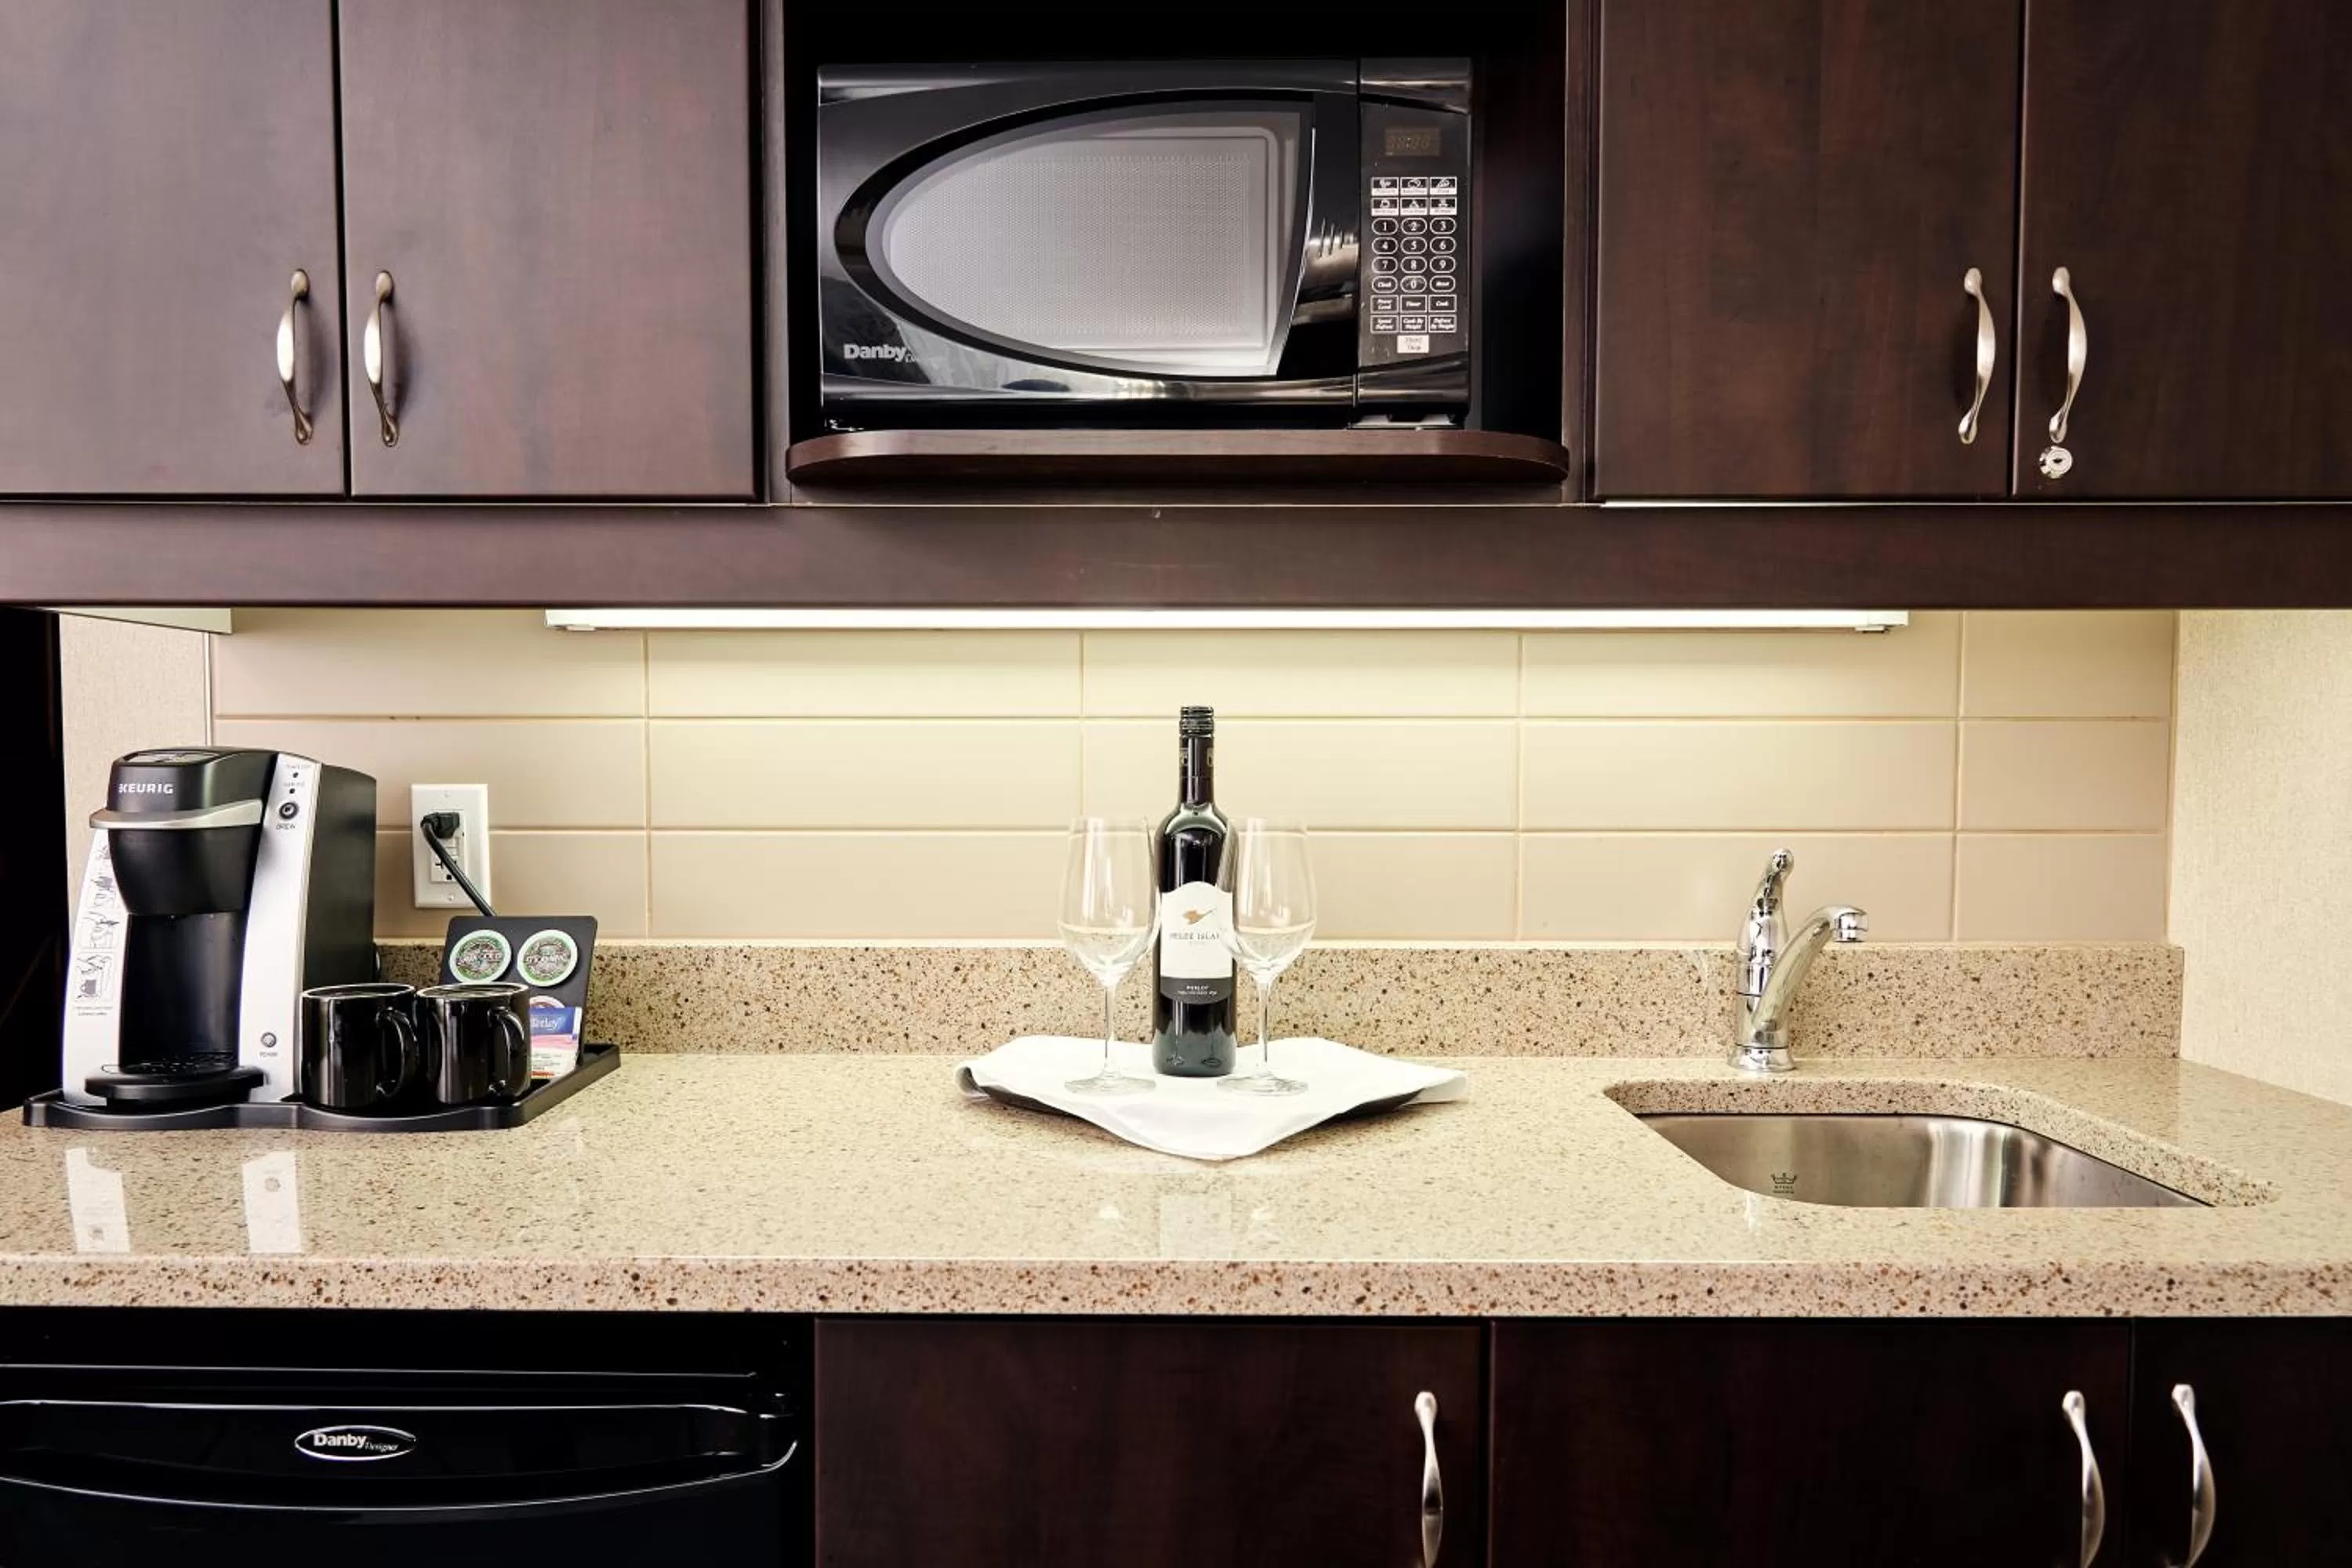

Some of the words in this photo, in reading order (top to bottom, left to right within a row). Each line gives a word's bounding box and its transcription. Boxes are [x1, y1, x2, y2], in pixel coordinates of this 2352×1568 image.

[1382, 221, 1387, 231] 1
[1410, 221, 1417, 231] 2
[1439, 220, 1446, 231] 3
[1382, 241, 1388, 250] 4
[1410, 241, 1417, 250] 5
[1439, 241, 1446, 250] 6
[1382, 260, 1388, 270] 7
[1410, 260, 1417, 270] 8
[1439, 260, 1446, 270] 9
[1410, 280, 1417, 289] 0
[843, 343, 906, 362] Danby
[118, 783, 174, 794] KEURIG
[314, 1433, 367, 1449] Danby
